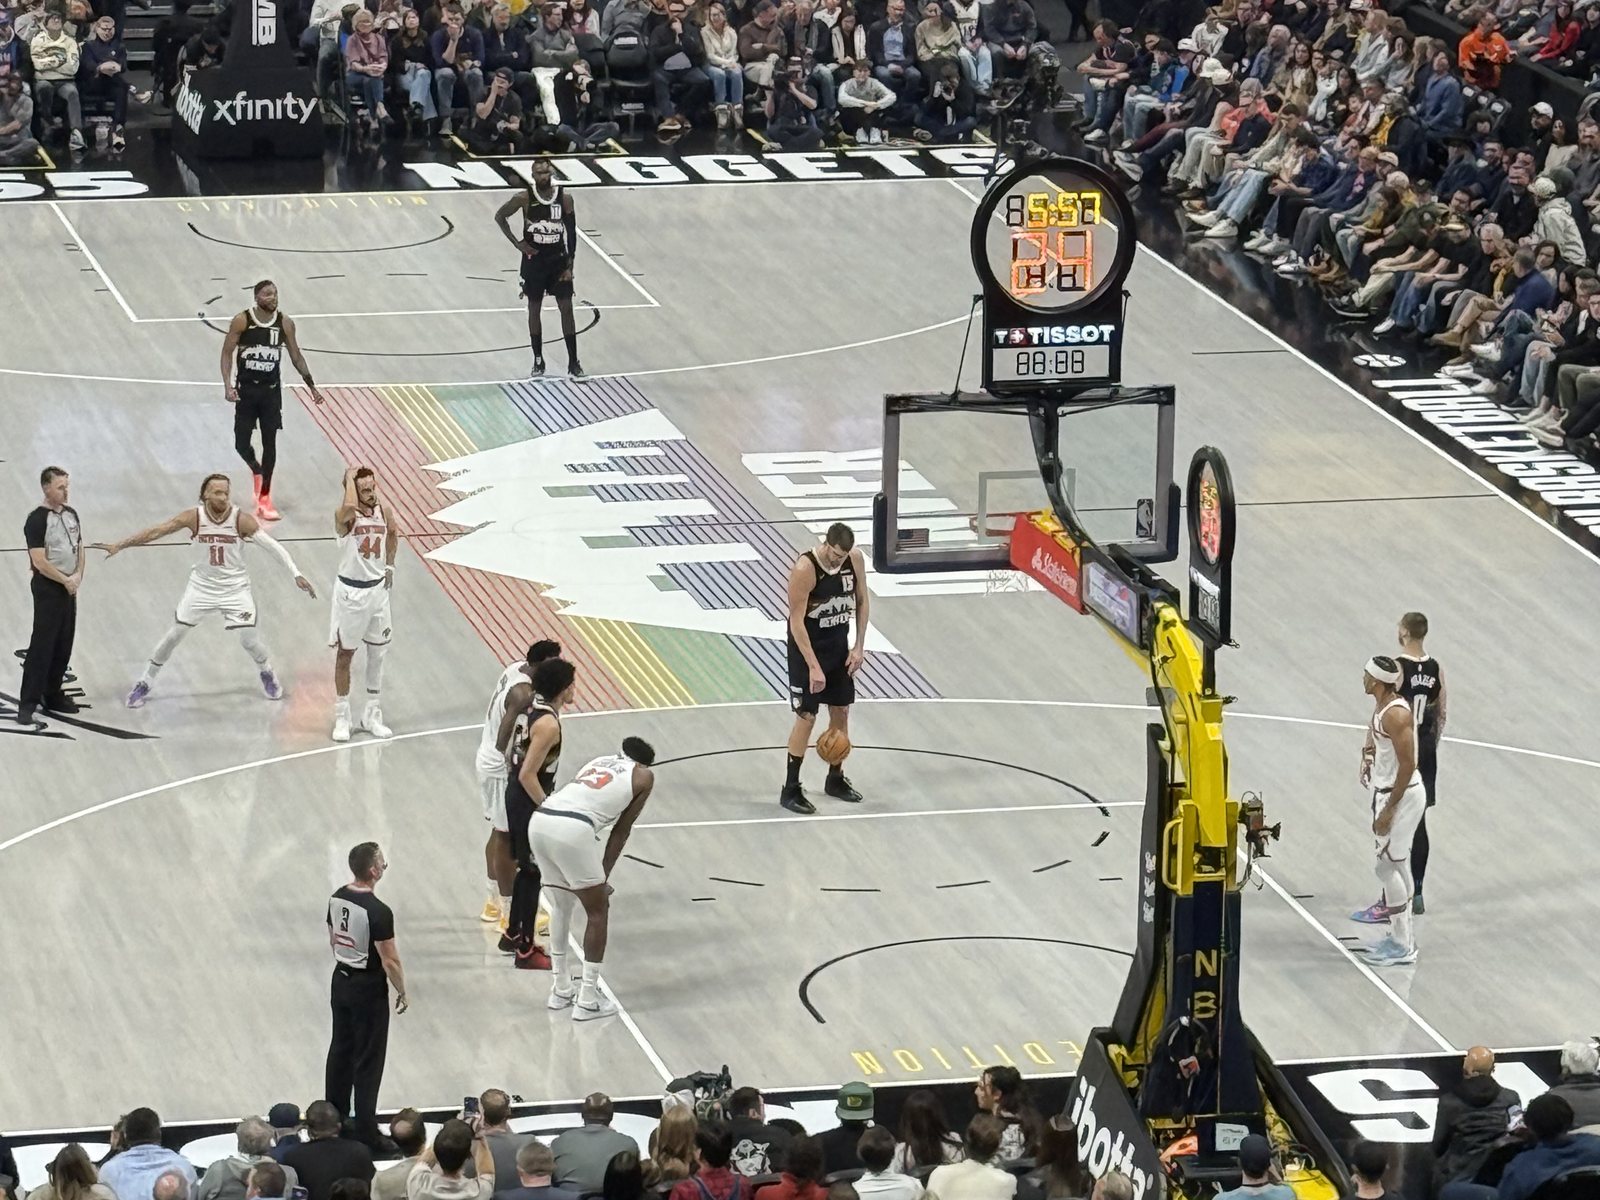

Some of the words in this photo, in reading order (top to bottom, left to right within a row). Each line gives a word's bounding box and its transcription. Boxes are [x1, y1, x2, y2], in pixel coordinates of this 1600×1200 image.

[213, 91, 319, 126] xfinity
[403, 147, 1016, 189] NUGGETS
[1027, 192, 1101, 229] 5:57
[1010, 230, 1093, 294] 24
[1027, 325, 1115, 345] TISSOT
[358, 536, 382, 560] 44
